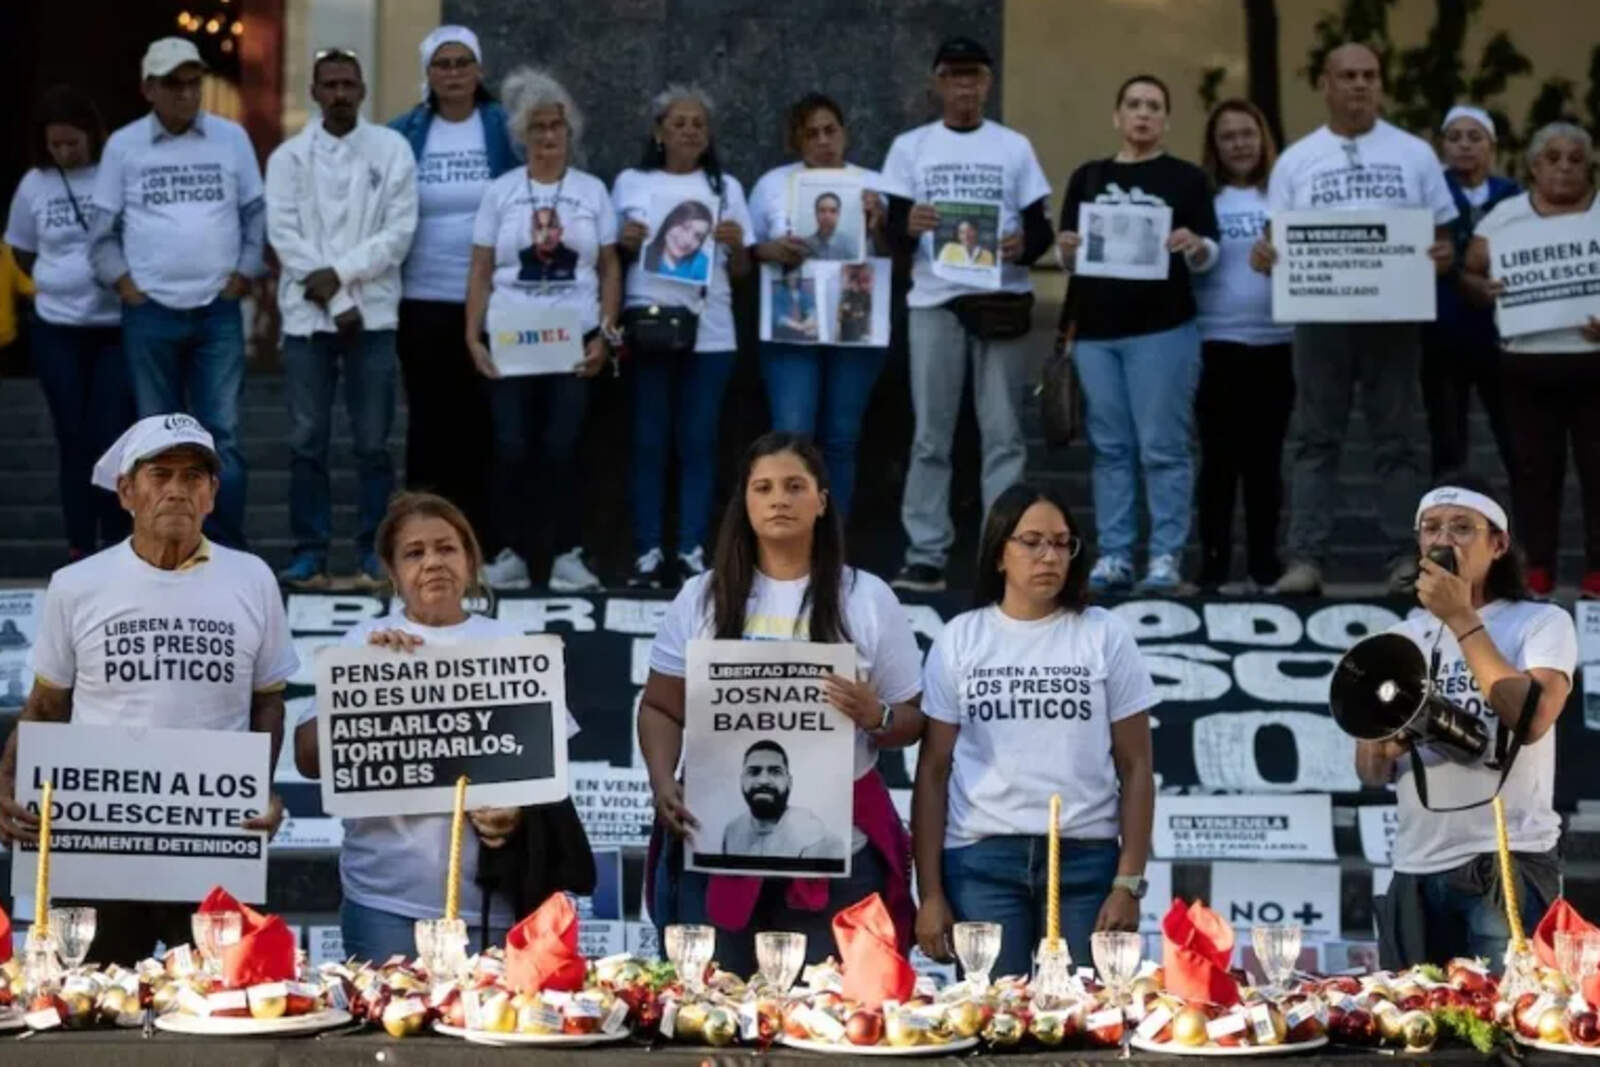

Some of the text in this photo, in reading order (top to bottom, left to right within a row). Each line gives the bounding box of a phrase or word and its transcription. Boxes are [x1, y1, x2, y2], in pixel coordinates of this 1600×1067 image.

[141, 173, 223, 190] LOS PRESOS
[1289, 247, 1303, 256] LA
[1500, 242, 1582, 268] LIBEREN
[1289, 261, 1296, 270] Y
[1300, 260, 1314, 270] LA
[105, 618, 236, 636] LIBEREN A TODOS
[104, 635, 236, 658] LOS PRESOS
[104, 653, 236, 683] POLÍTICOS
[331, 654, 550, 684] PENSAR DISTINTO
[711, 665, 783, 678] LIBERTAD
[1029, 666, 1039, 676] A
[1043, 666, 1091, 677] TODOS
[332, 679, 548, 708] NO ES UN DELITO.
[967, 678, 1091, 699] LOS PRESOS
[333, 710, 493, 740] AISLARLOS Y
[714, 711, 835, 731] BABUEL
[333, 734, 524, 763] TORTURARLOS,
[33, 766, 257, 799] LIBEREN A LOS
[335, 760, 434, 788] SÍ LO ES
[576, 780, 649, 792] EN VENE
[576, 796, 596, 807] SE
[158, 838, 258, 854] DETENIDOS
[1231, 902, 1284, 923] NO
